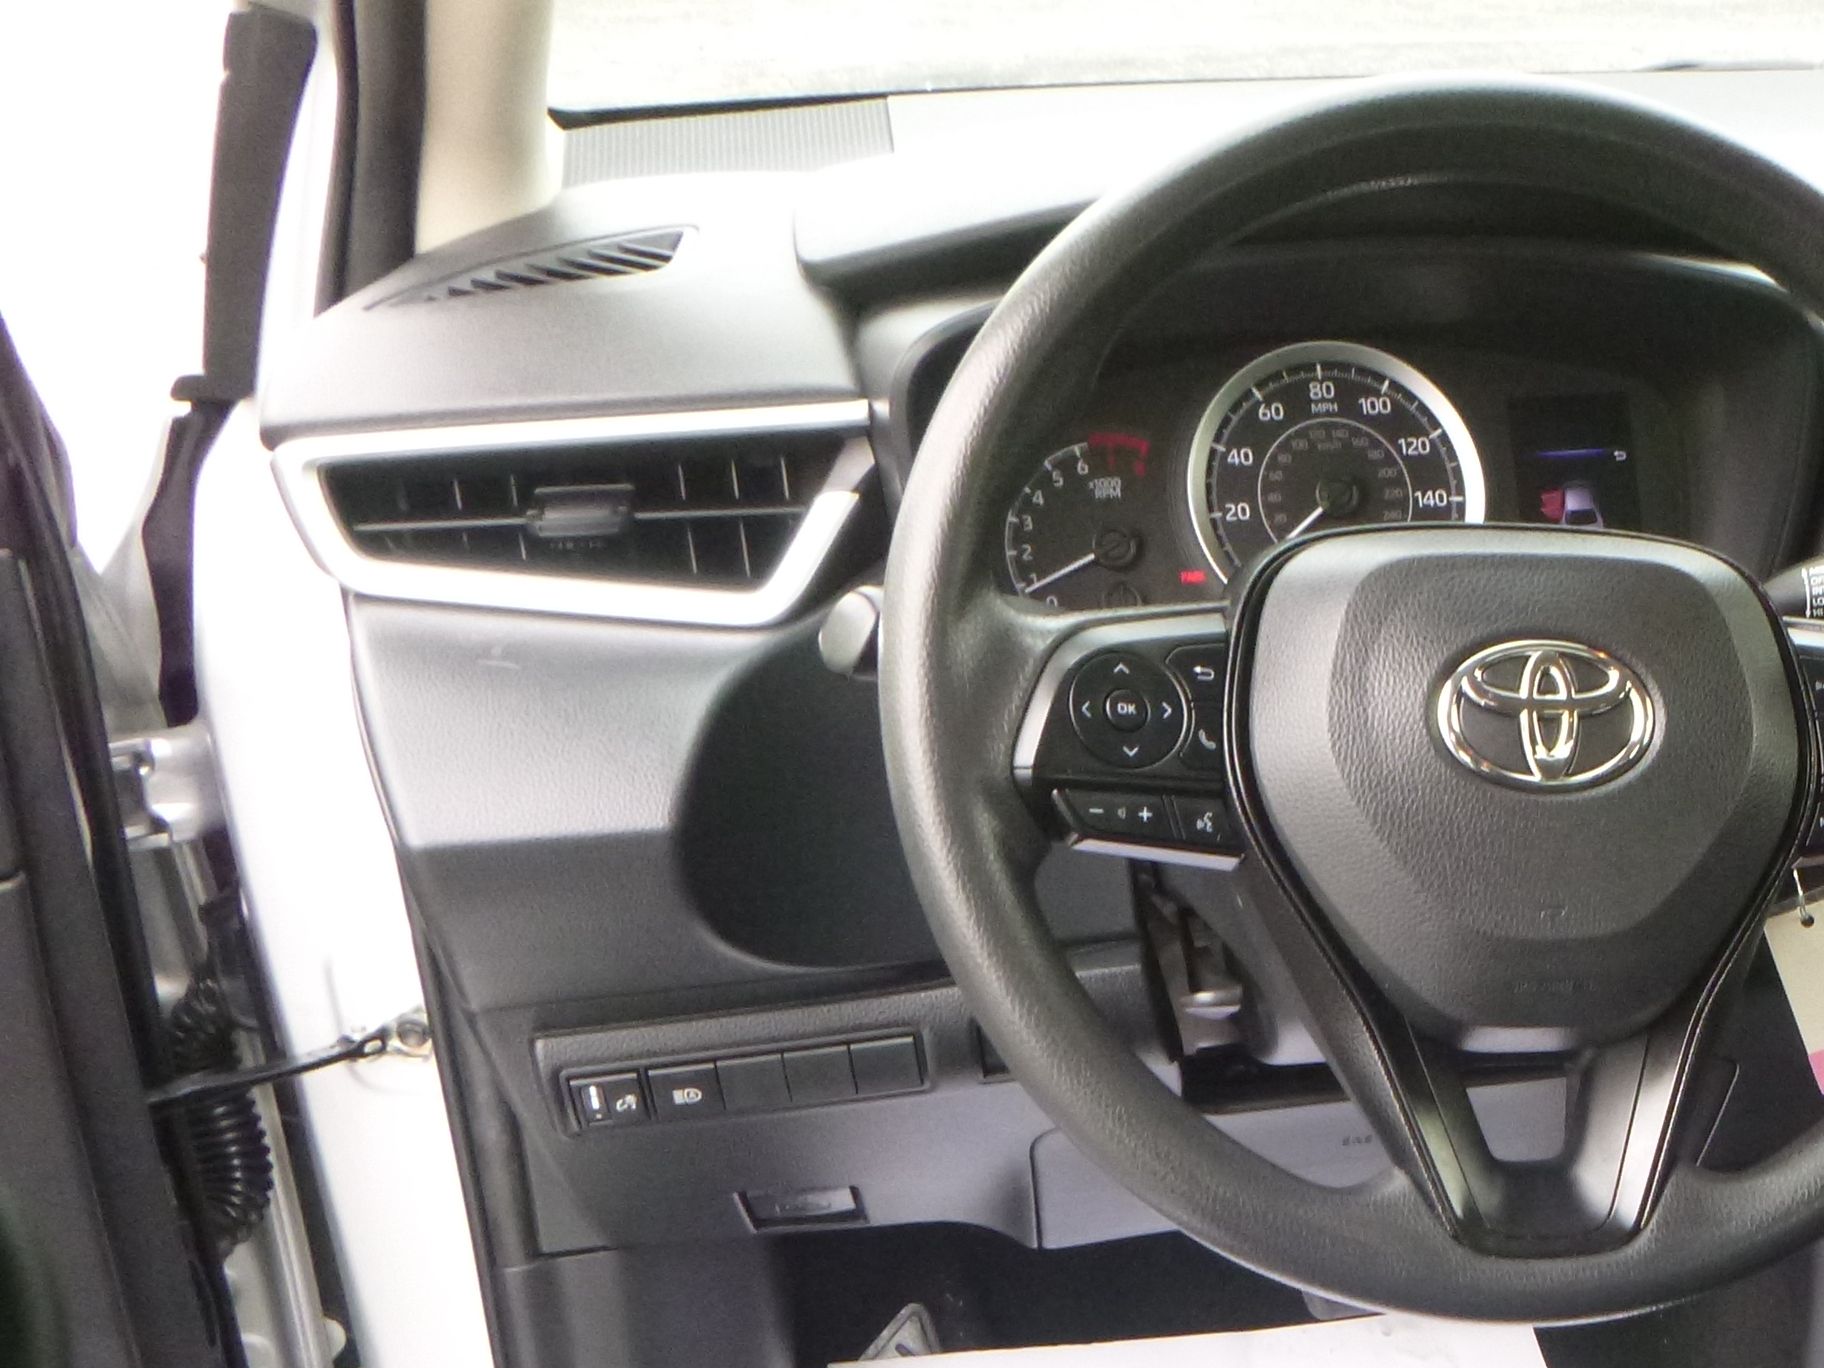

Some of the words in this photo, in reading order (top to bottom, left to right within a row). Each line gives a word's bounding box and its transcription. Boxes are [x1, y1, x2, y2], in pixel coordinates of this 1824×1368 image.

[1309, 382, 1334, 399] 80
[1258, 403, 1284, 420] 60
[1311, 402, 1338, 413] MPH
[1358, 397, 1391, 415] 100
[1398, 438, 1430, 456] 120
[1227, 448, 1253, 466] 40
[1077, 459, 1089, 475] 6
[1052, 471, 1064, 488] 5
[1032, 490, 1044, 506] 4
[1095, 488, 1121, 499] RPM
[1415, 489, 1447, 507] 140
[1225, 502, 1249, 521] 20
[1022, 515, 1033, 531] 3
[1022, 545, 1033, 561] 2
[1812, 608, 1824, 617] HI
[1117, 703, 1137, 715] OK
